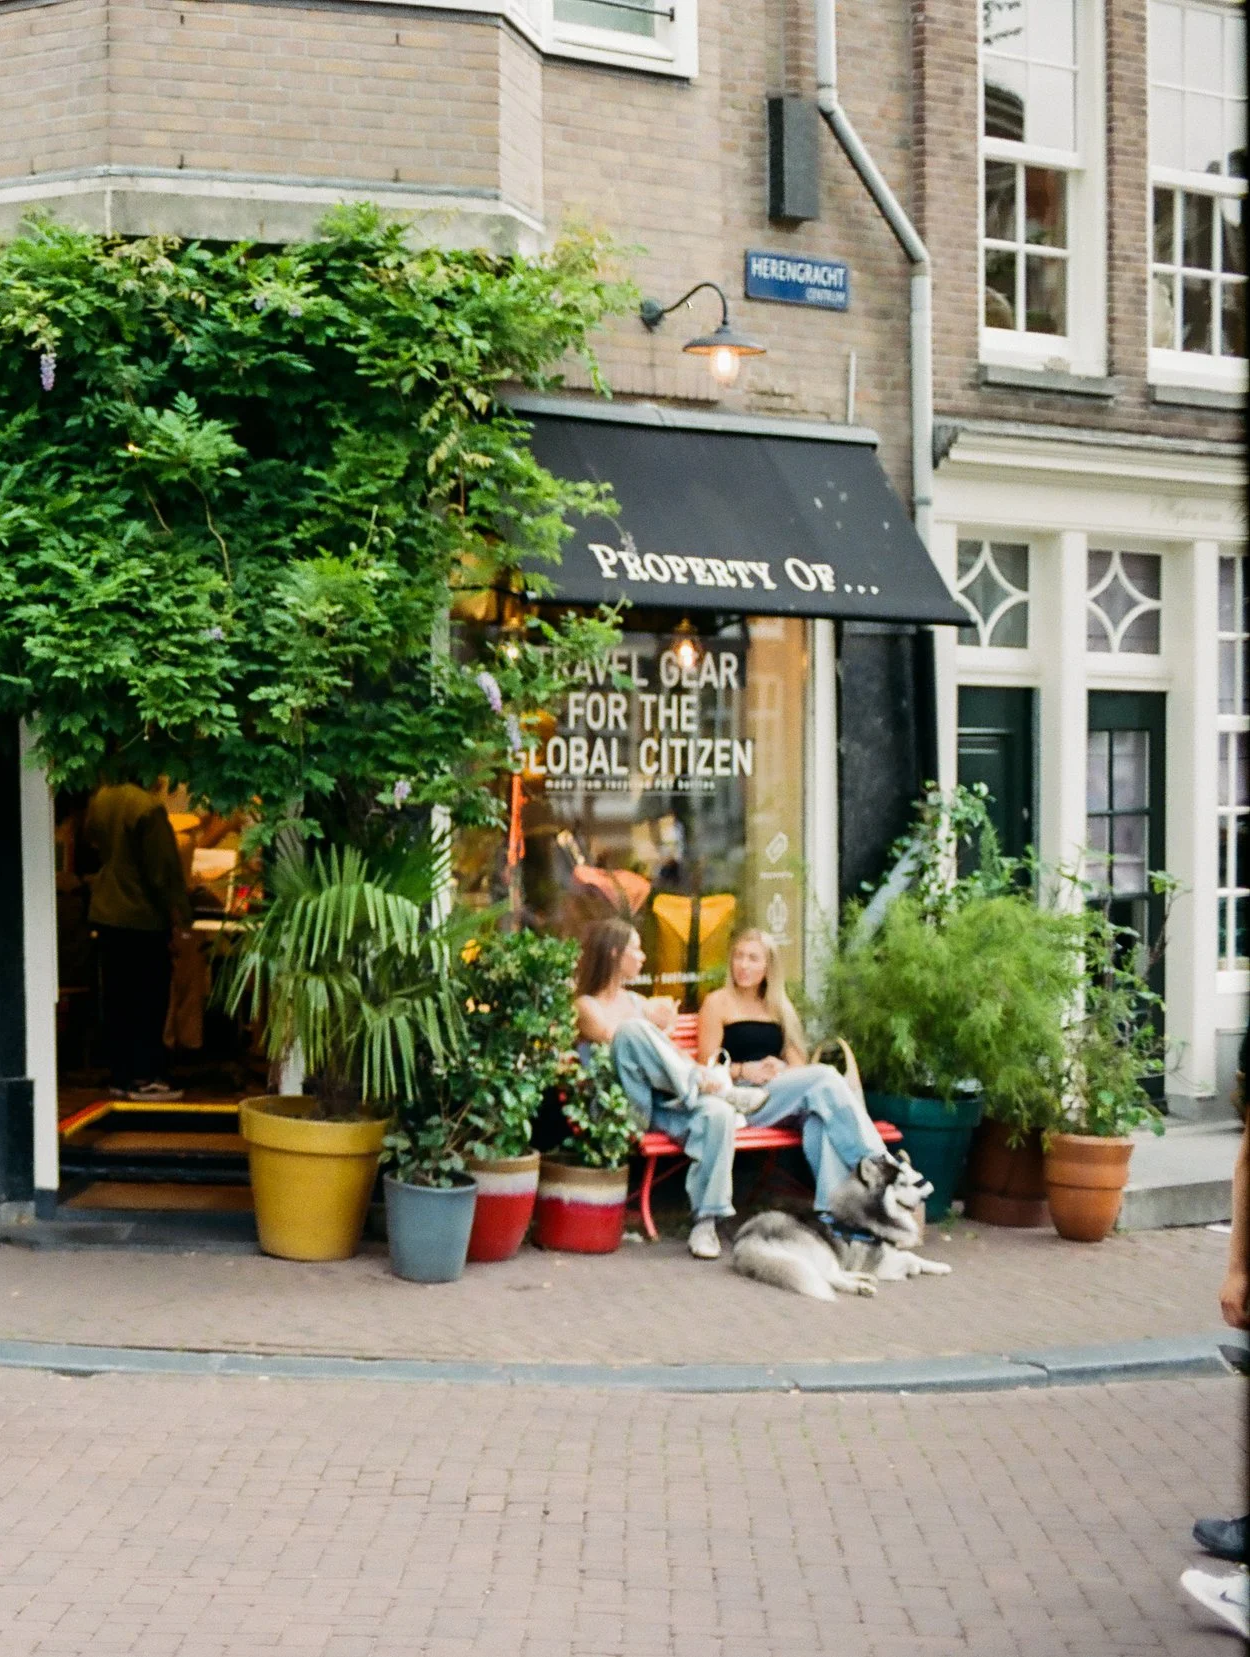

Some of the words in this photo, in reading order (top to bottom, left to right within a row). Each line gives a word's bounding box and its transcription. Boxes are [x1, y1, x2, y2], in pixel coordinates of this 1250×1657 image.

[751, 256, 846, 288] HERENGRACHT
[588, 543, 778, 590] PROPERTY
[660, 650, 739, 690] GEAR
[568, 691, 628, 731] FOR
[639, 693, 699, 732] THE
[508, 735, 629, 775] GLOBAL
[639, 737, 753, 776] CITIZEN
